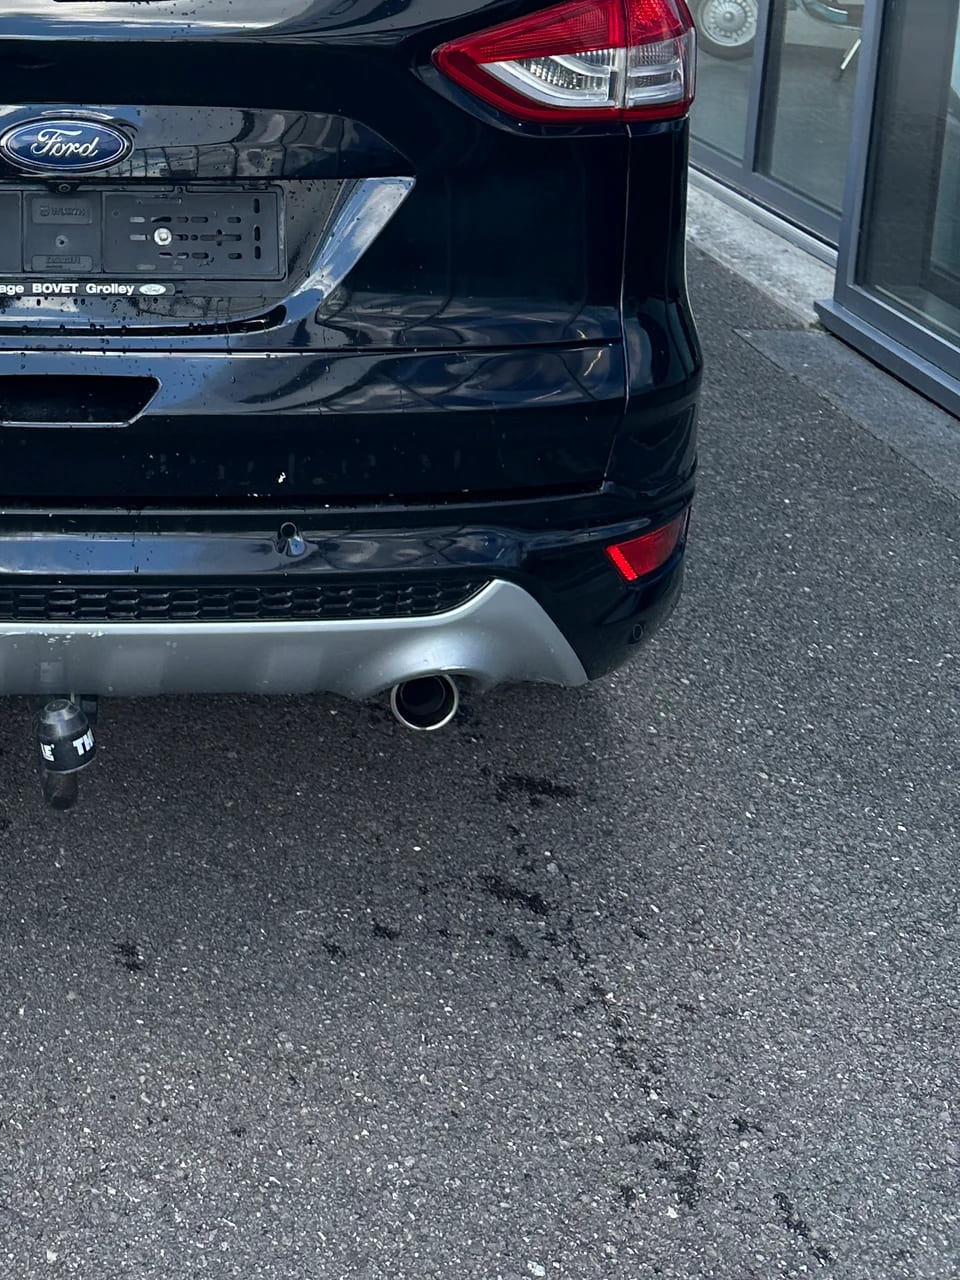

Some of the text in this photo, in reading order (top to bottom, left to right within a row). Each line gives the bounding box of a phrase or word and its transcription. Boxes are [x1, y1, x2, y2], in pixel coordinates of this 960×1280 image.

[30, 128, 100, 157] Ford
[32, 282, 79, 294] BOVET
[85, 282, 135, 297] Grolley
